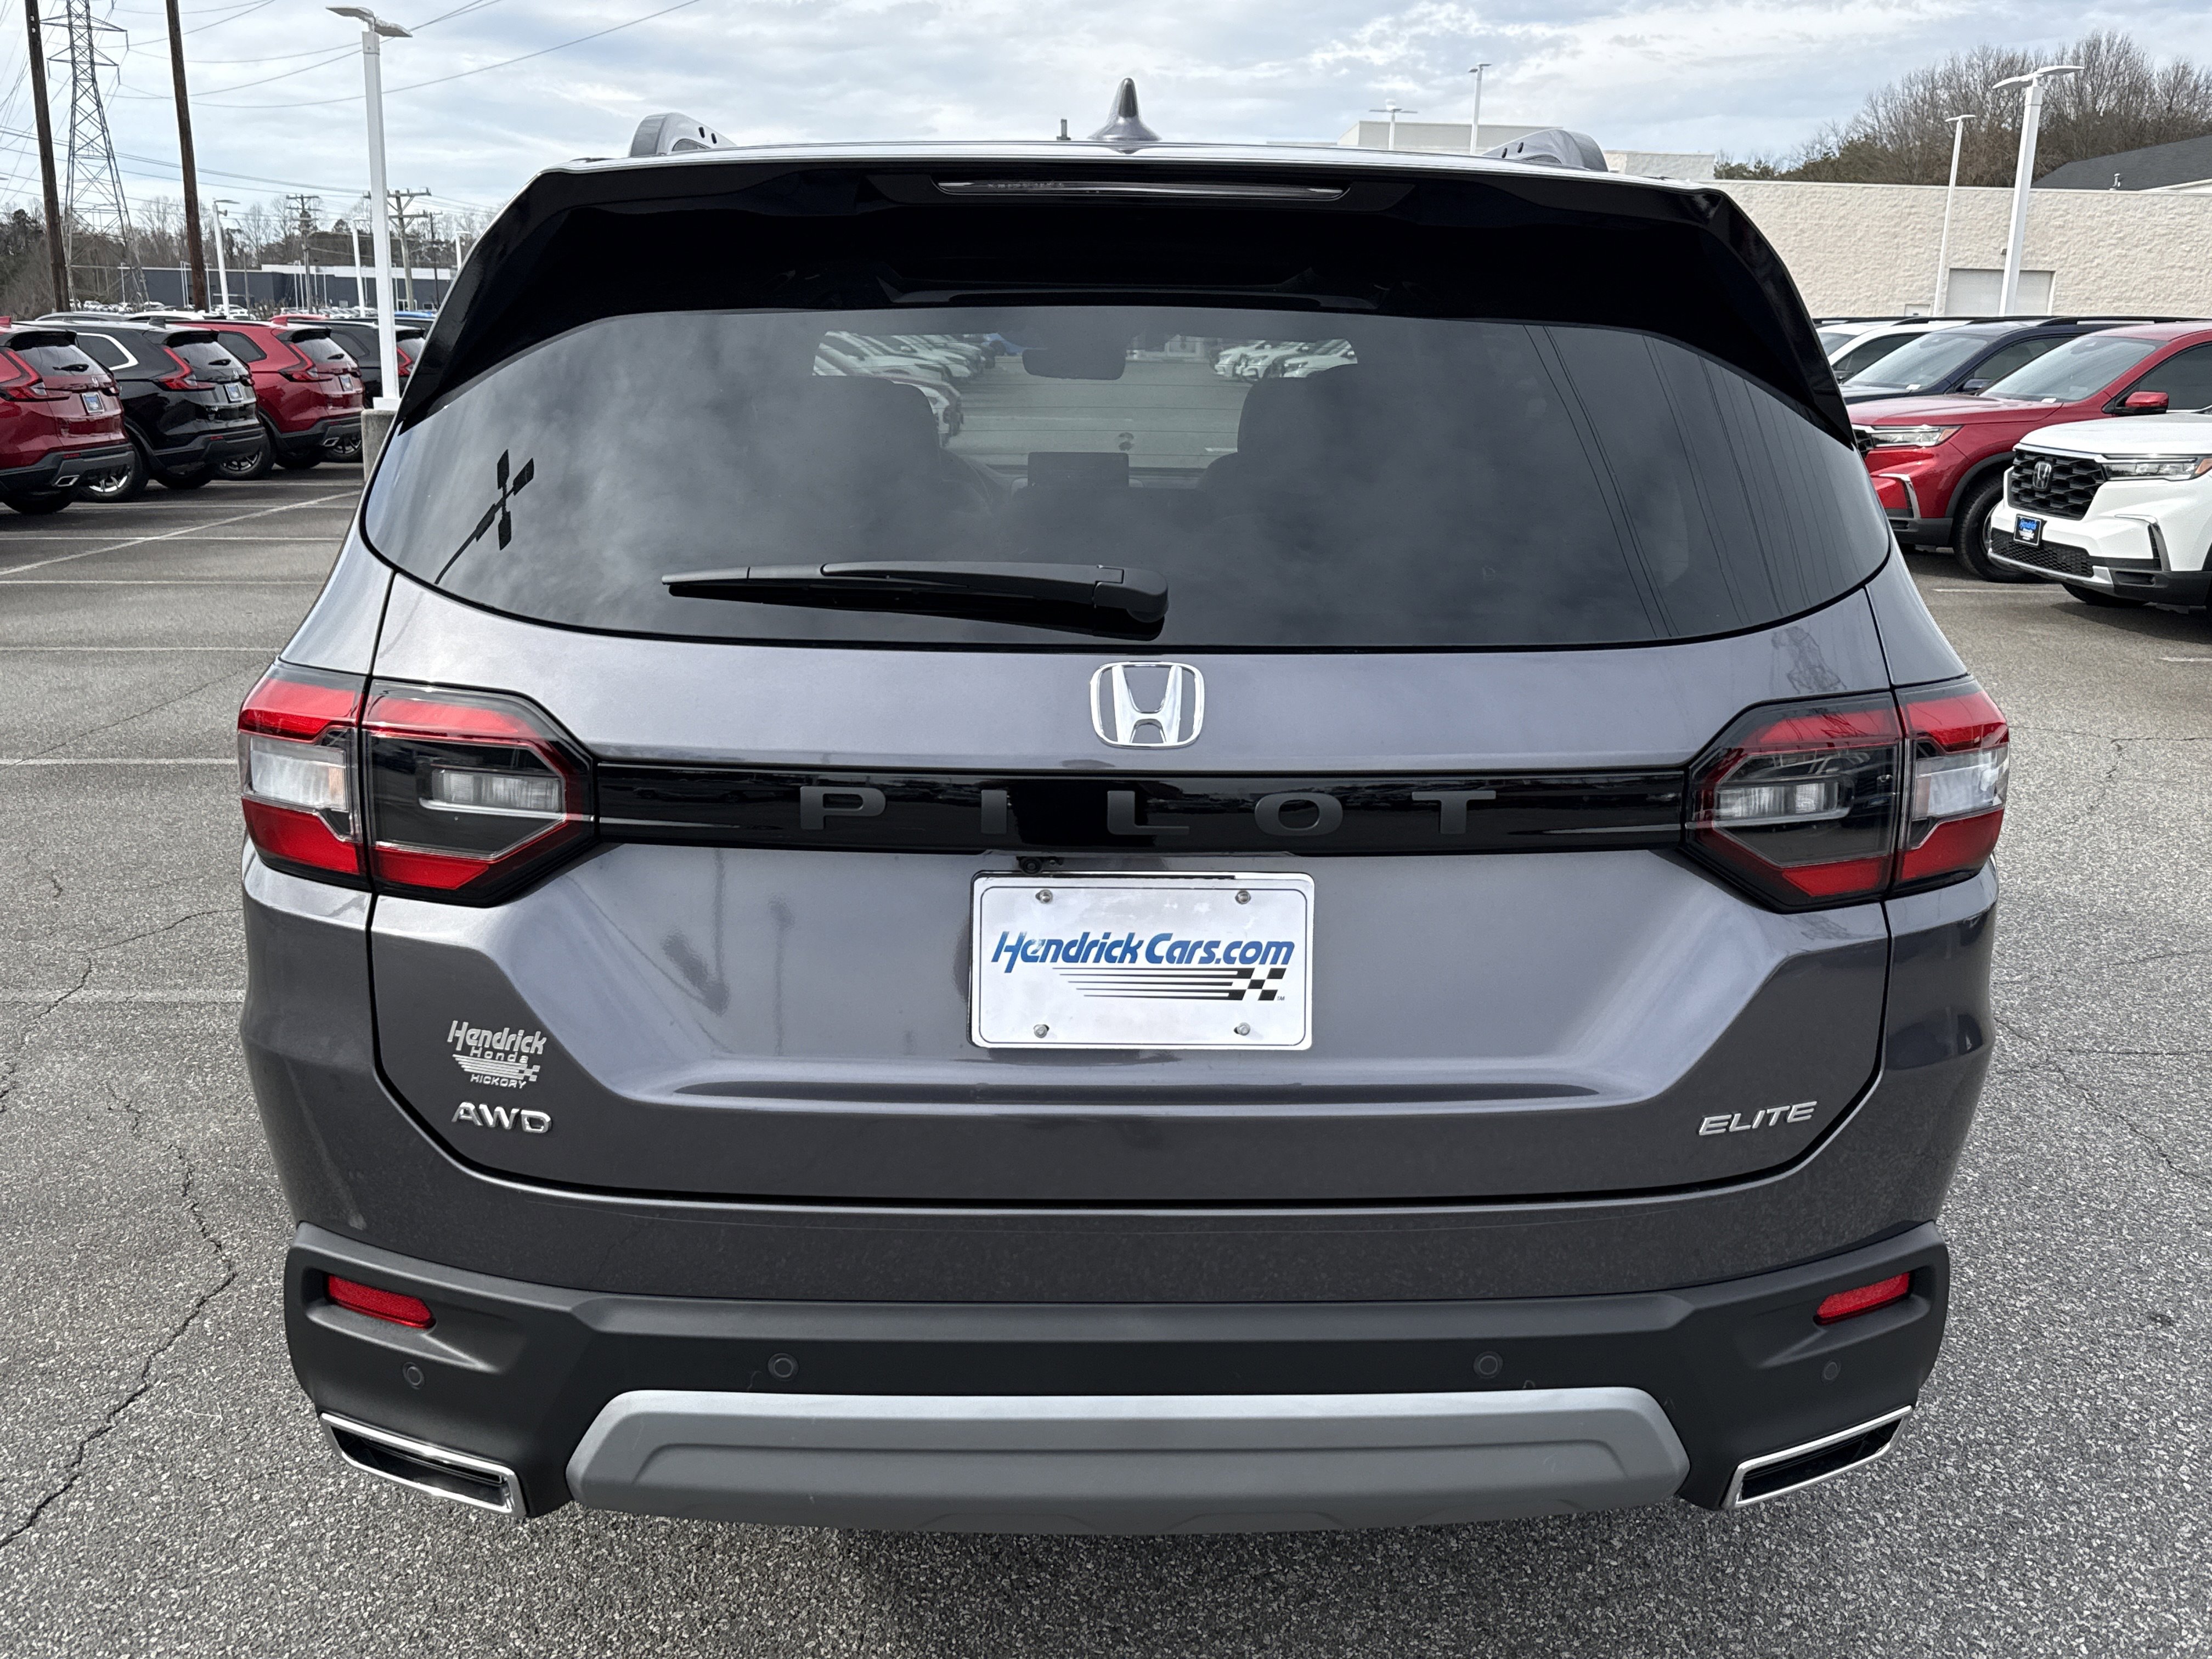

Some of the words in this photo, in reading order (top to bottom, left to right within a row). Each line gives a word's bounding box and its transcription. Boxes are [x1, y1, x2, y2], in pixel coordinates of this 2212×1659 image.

[799, 785, 1497, 836] PILOT
[447, 1020, 546, 1054] Hendrick
[469, 1047, 529, 1063] Honda
[470, 1074, 527, 1090] HICKORY
[451, 1101, 552, 1134] AWD
[1698, 1101, 1818, 1136] ELITE
